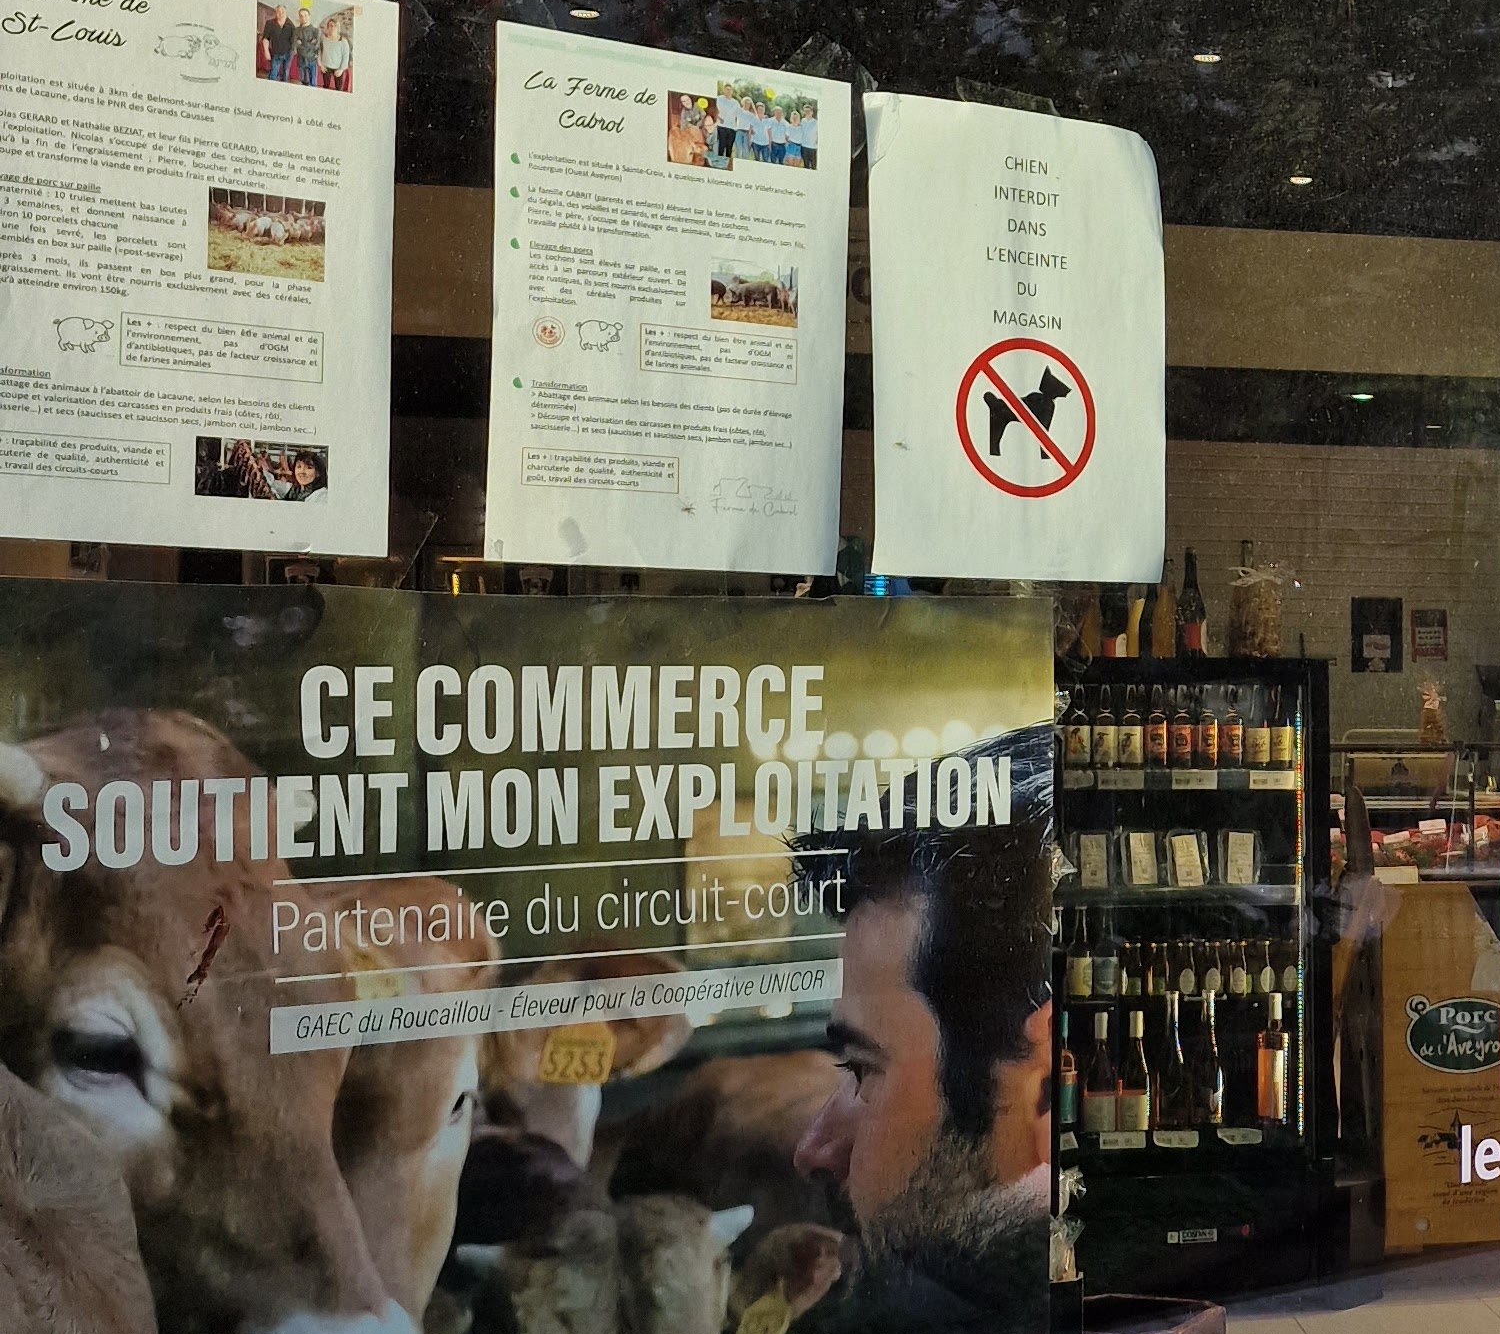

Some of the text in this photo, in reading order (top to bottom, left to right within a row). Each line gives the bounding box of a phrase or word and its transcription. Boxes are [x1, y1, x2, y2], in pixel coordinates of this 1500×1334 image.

[2, 12, 127, 46] St-Louis
[524, 70, 658, 105] La Ferme de
[559, 109, 625, 133] Cabrol
[1004, 155, 1048, 175] CHIEN
[994, 185, 1060, 208] INTERDIT
[1008, 218, 1046, 237] DANS
[987, 246, 1067, 270] L'ENCEINTE
[1017, 281, 1037, 297] DU
[993, 310, 1062, 331] MAGASIN
[300, 663, 825, 758] CE COMMERCE
[41, 756, 1012, 872] SOUTIENT MON EXPLOITATION
[272, 869, 846, 955] Partenaire du circuit-court
[297, 1012, 353, 1039] GAEC
[359, 1008, 384, 1035] du
[389, 1001, 491, 1032] Roucaillou
[510, 990, 577, 1020] Éleveur
[582, 991, 624, 1017] pour
[631, 985, 646, 1008] la
[652, 975, 754, 1011] Coopérative
[760, 968, 825, 996] UNICOR
[1439, 1007, 1498, 1025] Porc
[1438, 1035, 1500, 1061] l'Aveyro
